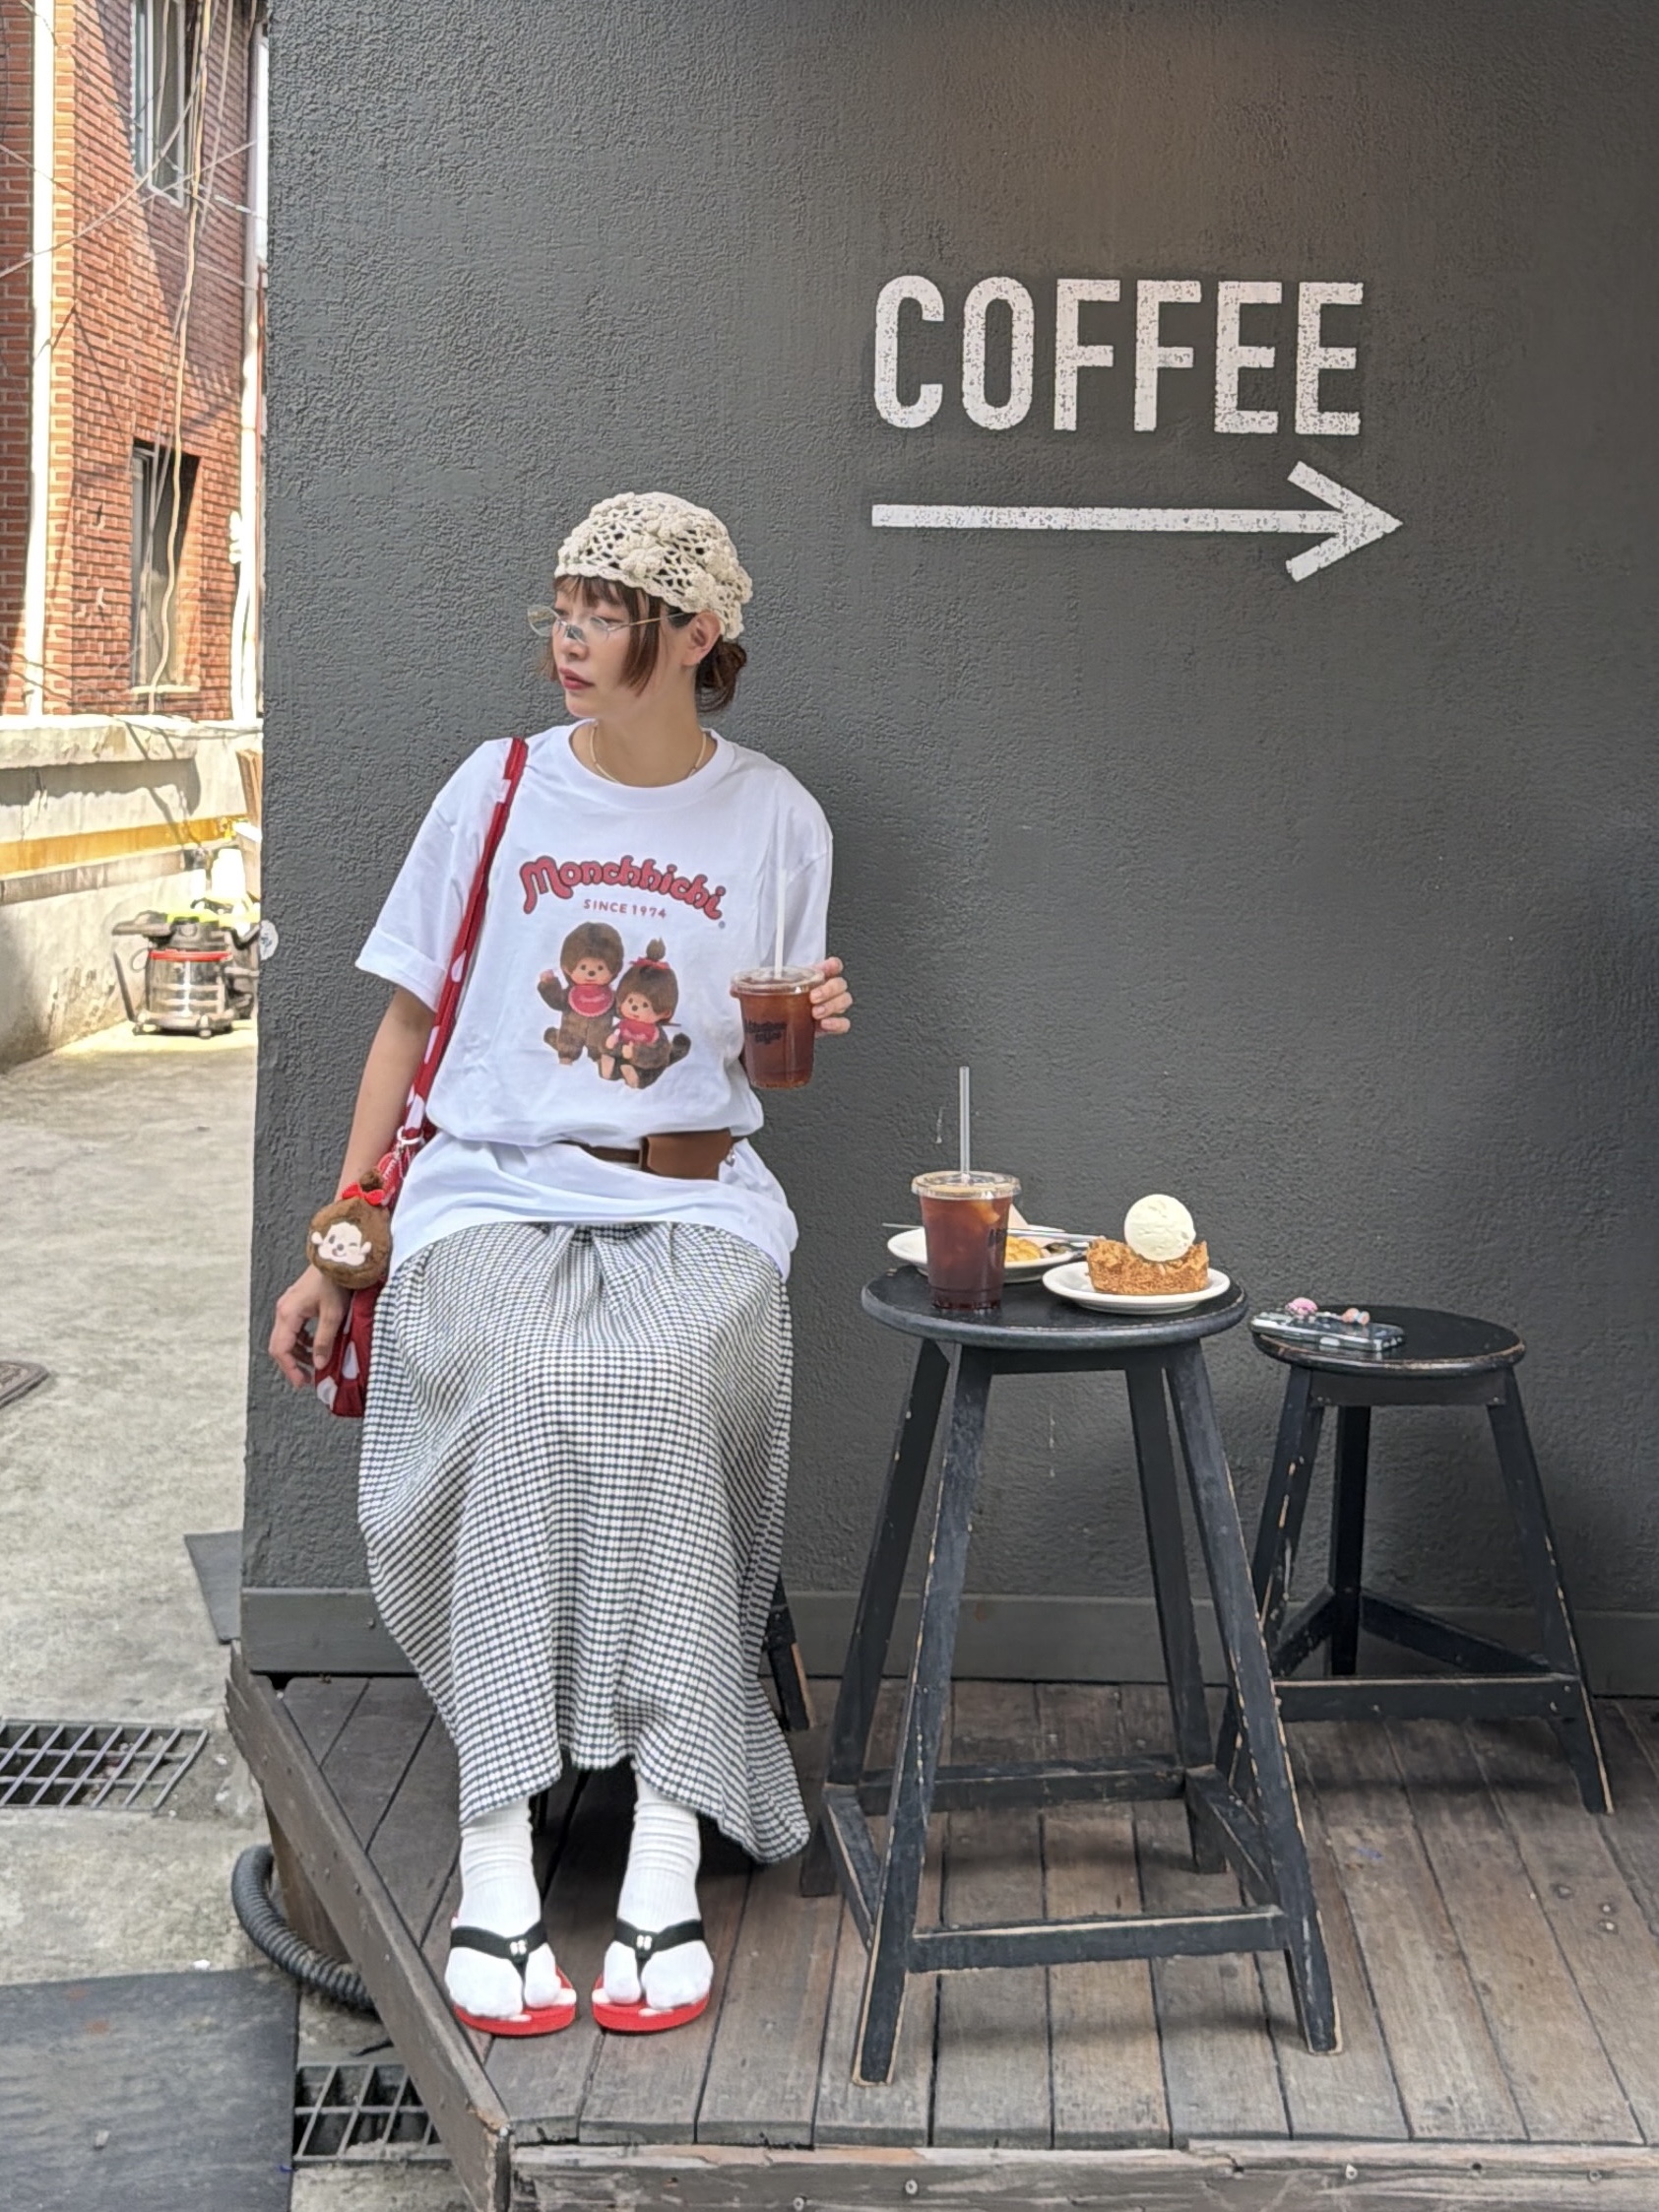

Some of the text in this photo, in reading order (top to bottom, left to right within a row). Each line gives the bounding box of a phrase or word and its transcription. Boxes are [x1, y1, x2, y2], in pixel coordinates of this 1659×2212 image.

[874, 275, 1364, 435] COFFEE
[519, 855, 727, 920] Monchhichi
[583, 898, 667, 919] SINCE 1974
